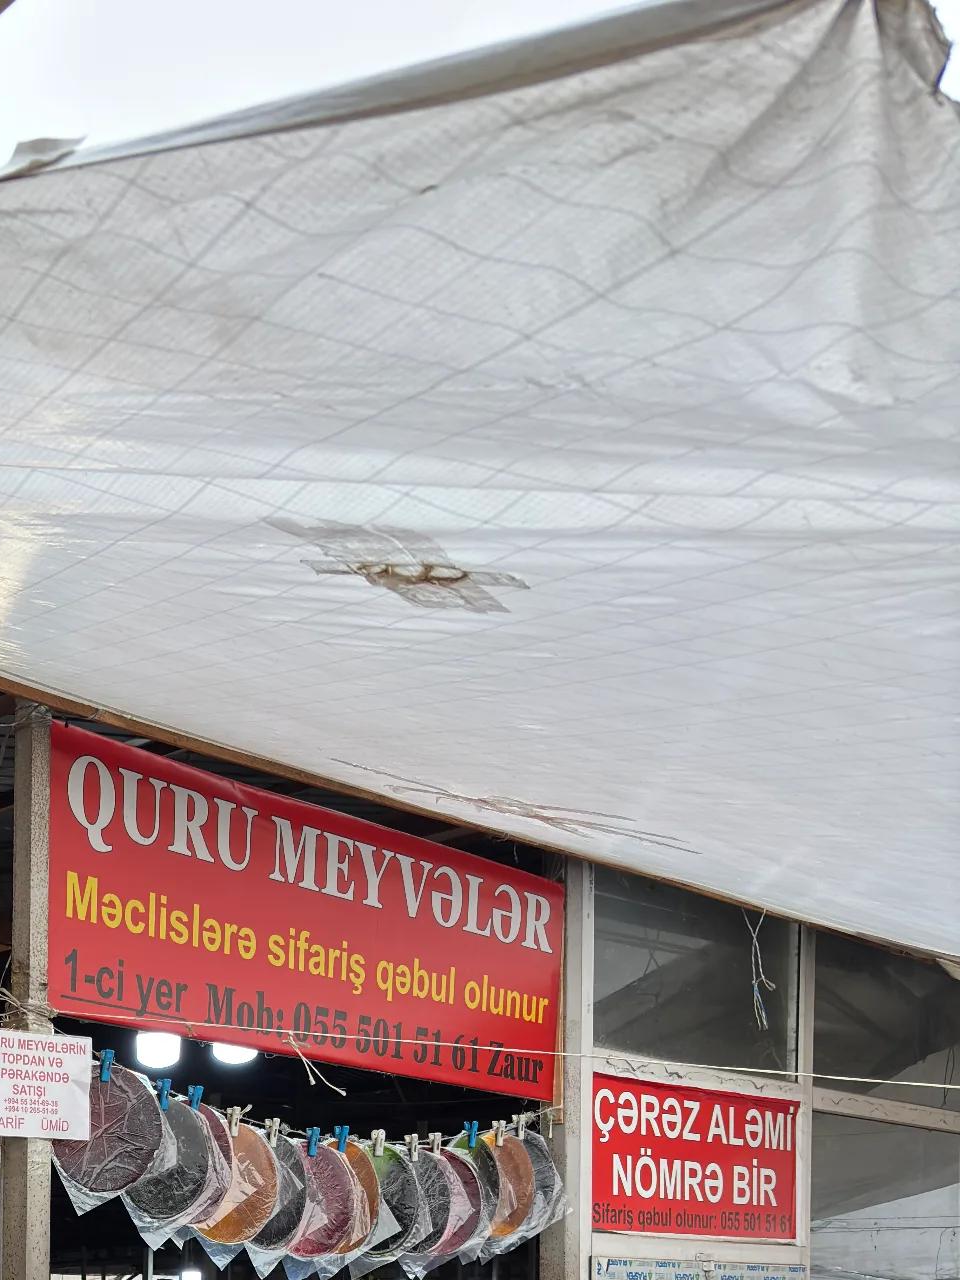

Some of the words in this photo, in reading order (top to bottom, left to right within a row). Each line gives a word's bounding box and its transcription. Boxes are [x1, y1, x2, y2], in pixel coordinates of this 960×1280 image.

[66, 754, 259, 872] QURU
[268, 816, 554, 954] MEYVƏLƏR
[65, 870, 257, 960] Məclislərə
[267, 929, 366, 994] sifariş
[376, 957, 455, 1005] qəbul
[464, 981, 549, 1024] olunur
[64, 948, 125, 1002] 1-ci
[136, 973, 188, 1017] yer
[205, 983, 284, 1038] Mob:
[294, 1002, 348, 1049] 055
[355, 1015, 404, 1060] 501
[413, 1027, 443, 1067] 51
[452, 1034, 480, 1073] 61
[488, 1040, 544, 1084] Zaur
[2, 1053, 45, 1066] TOPDAN
[48, 1058, 63, 1068] VƏ
[18, 1039, 86, 1056] MEYVƏLƏRİN
[0, 1068, 70, 1083] PƏRAKƏNDƏ
[12, 1084, 46, 1099] SATIŞI
[41, 1118, 69, 1132] ÜMİD
[594, 1088, 701, 1143] ÇƏRƏZ
[707, 1103, 795, 1151] ALƏMİ
[612, 1148, 724, 1204] NÖMRƏ
[732, 1158, 778, 1207] BİR
[592, 1203, 633, 1229] Sifariş
[638, 1208, 672, 1230] qəbul
[676, 1211, 717, 1230] olunur:
[720, 1213, 740, 1231] 055
[743, 1214, 761, 1231] 501
[765, 1214, 777, 1232] 51
